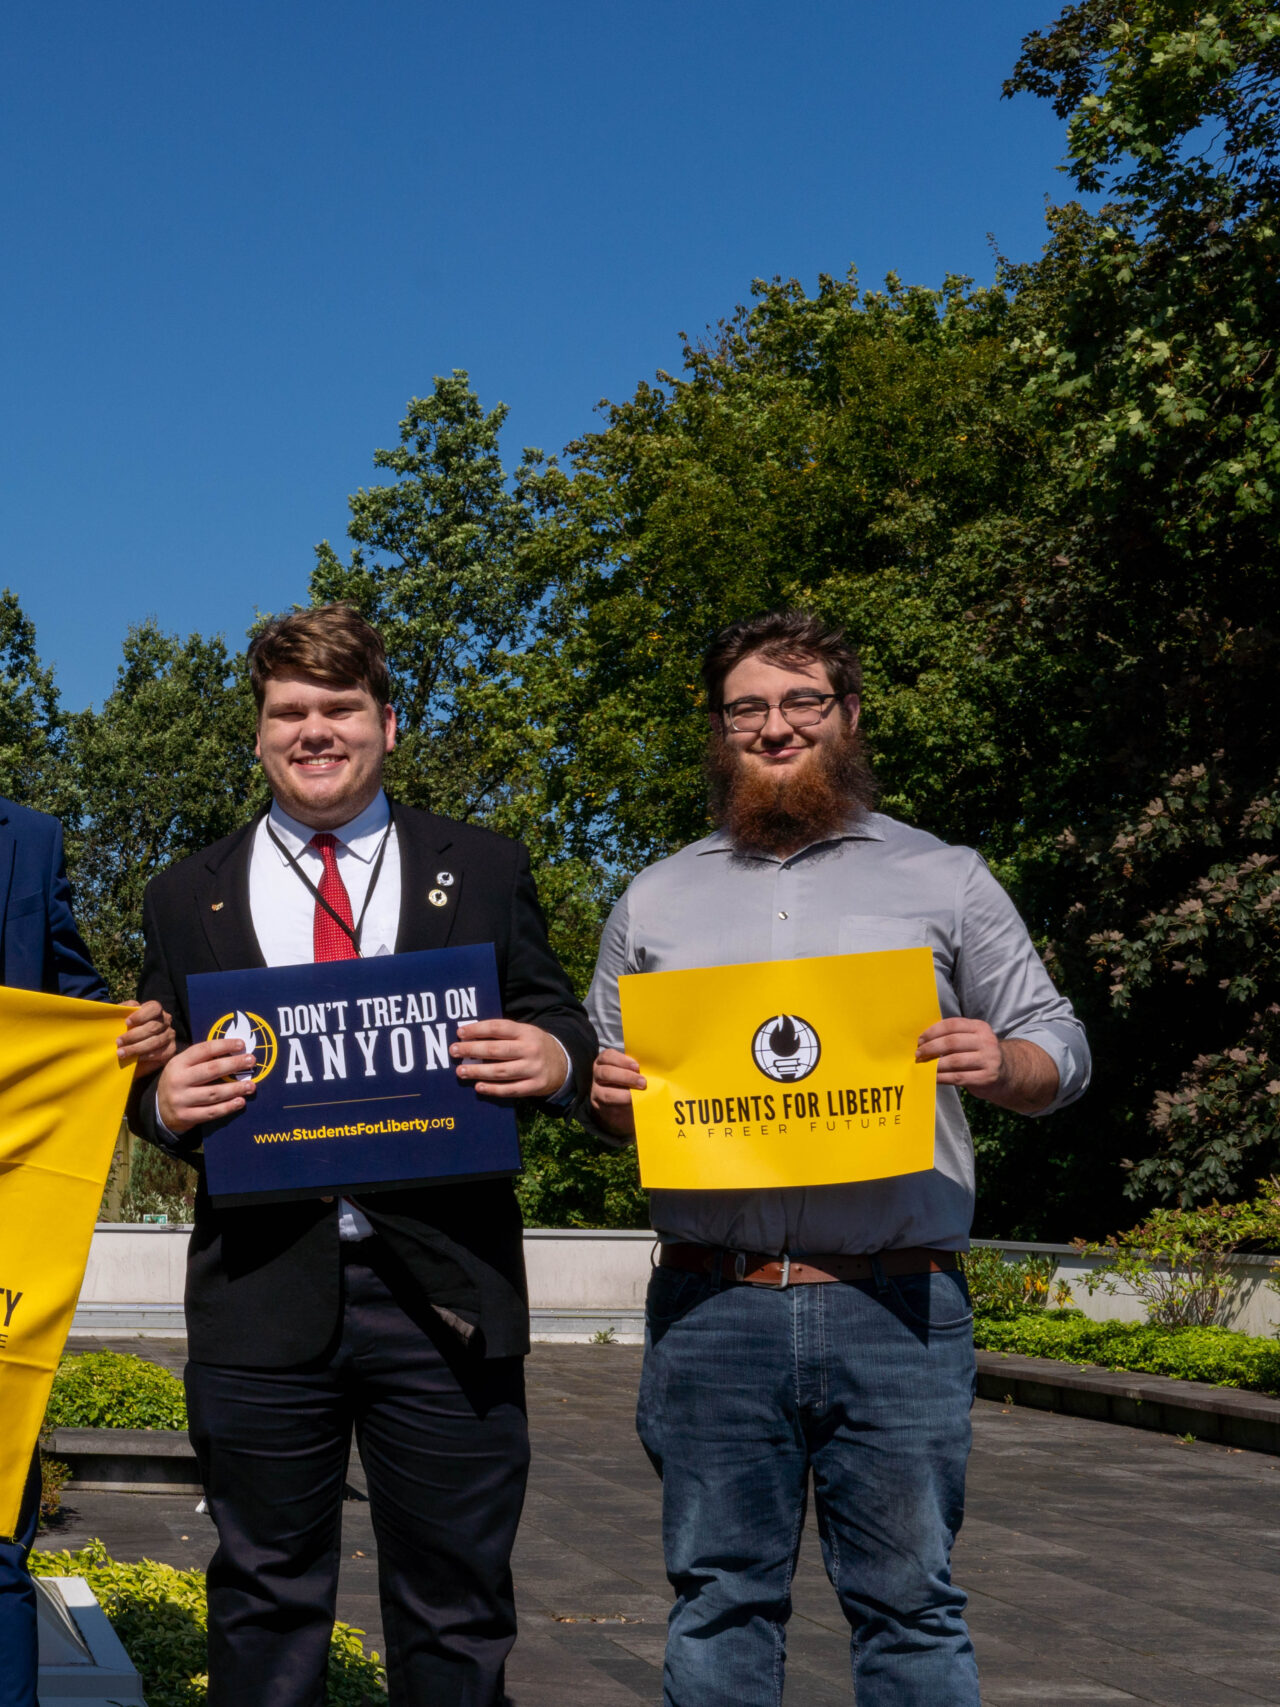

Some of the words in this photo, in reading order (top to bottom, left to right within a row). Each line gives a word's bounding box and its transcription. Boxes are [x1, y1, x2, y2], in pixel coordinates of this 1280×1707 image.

[277, 1001, 348, 1037] DON'T
[357, 992, 437, 1029] TREAD
[444, 987, 478, 1020] ON
[285, 1019, 484, 1084] ANYON
[674, 1095, 776, 1126] STUDENTS
[783, 1092, 820, 1120] FOR
[827, 1085, 905, 1117] LIBERTY
[254, 1116, 455, 1144] www.StudentsForLiberty.org
[677, 1129, 686, 1139] A
[708, 1123, 787, 1138] FREER
[810, 1115, 901, 1132] FUTURE
